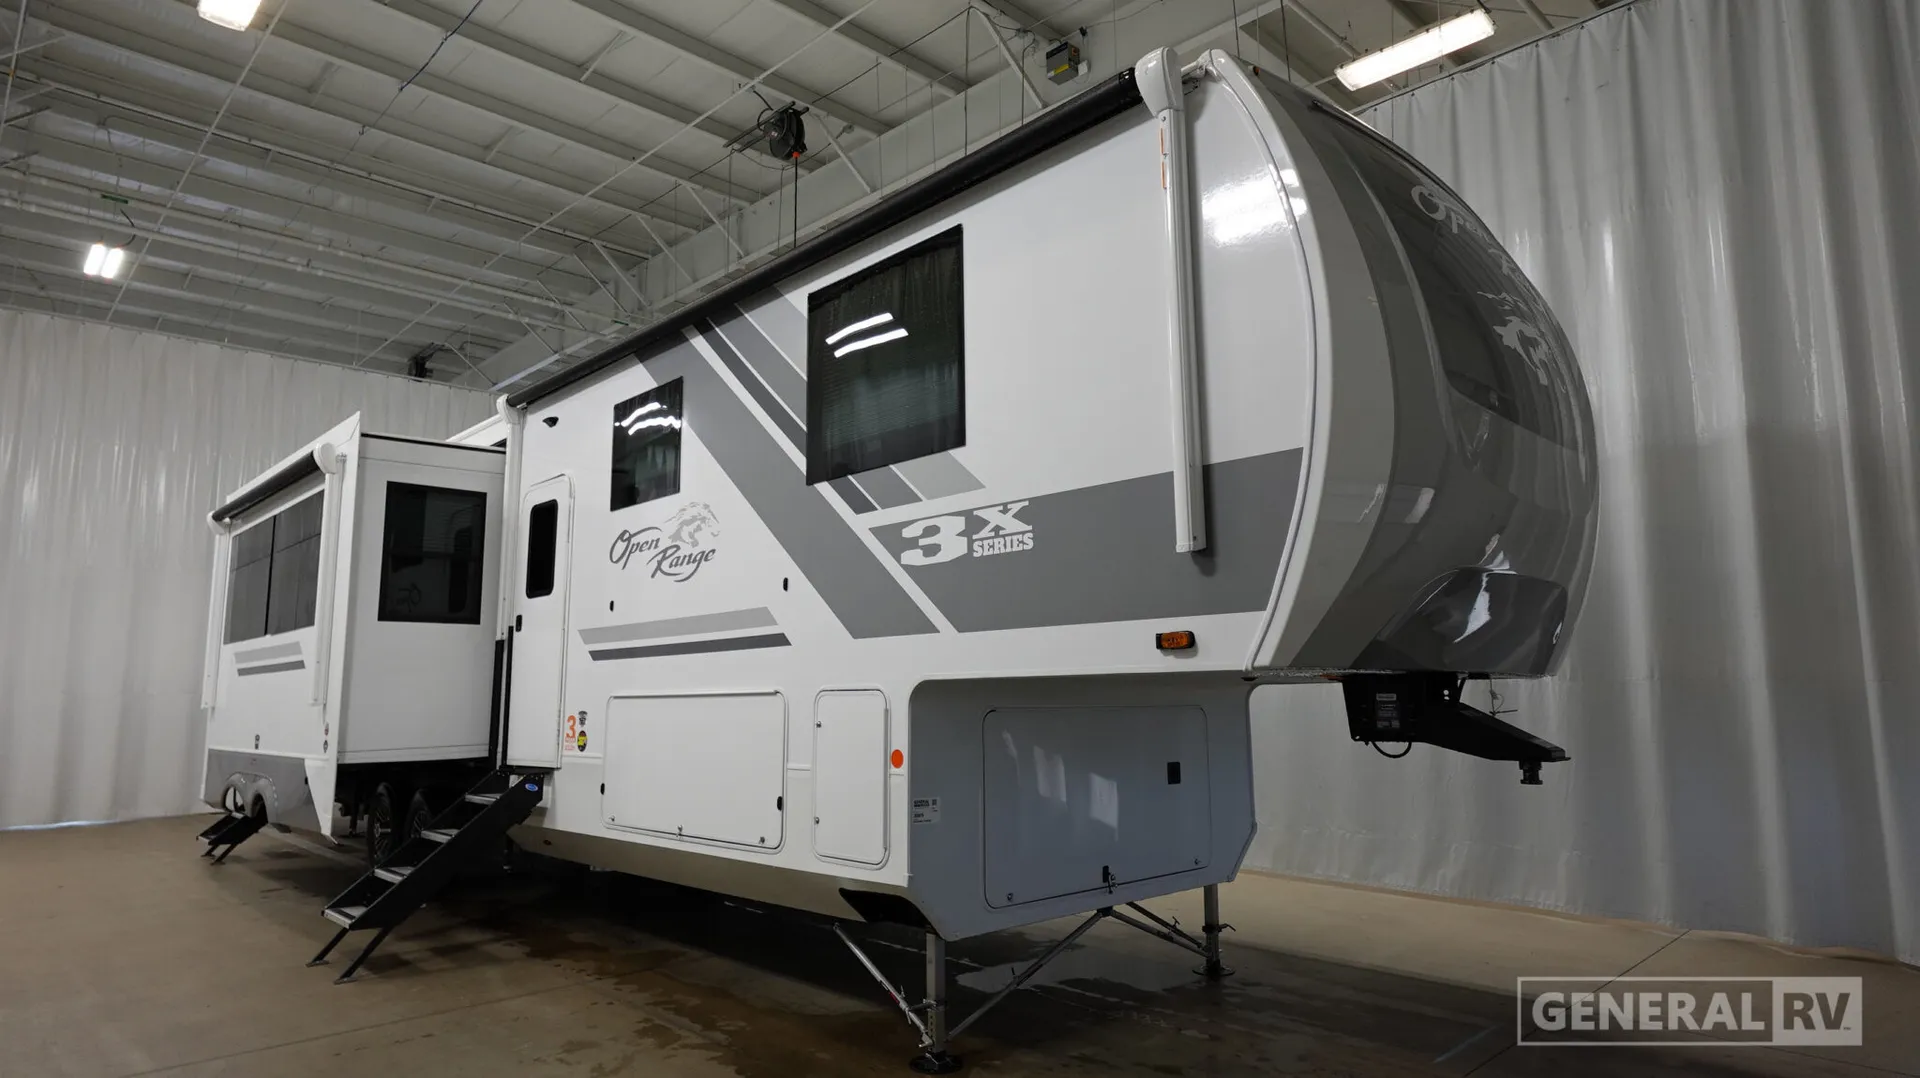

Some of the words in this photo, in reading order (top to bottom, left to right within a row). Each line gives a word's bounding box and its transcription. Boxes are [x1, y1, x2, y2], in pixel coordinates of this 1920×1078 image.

[972, 500, 1033, 540] X
[609, 526, 663, 570] Open
[646, 544, 716, 582] Range
[973, 532, 1034, 557] SERIES
[566, 714, 577, 739] 3
